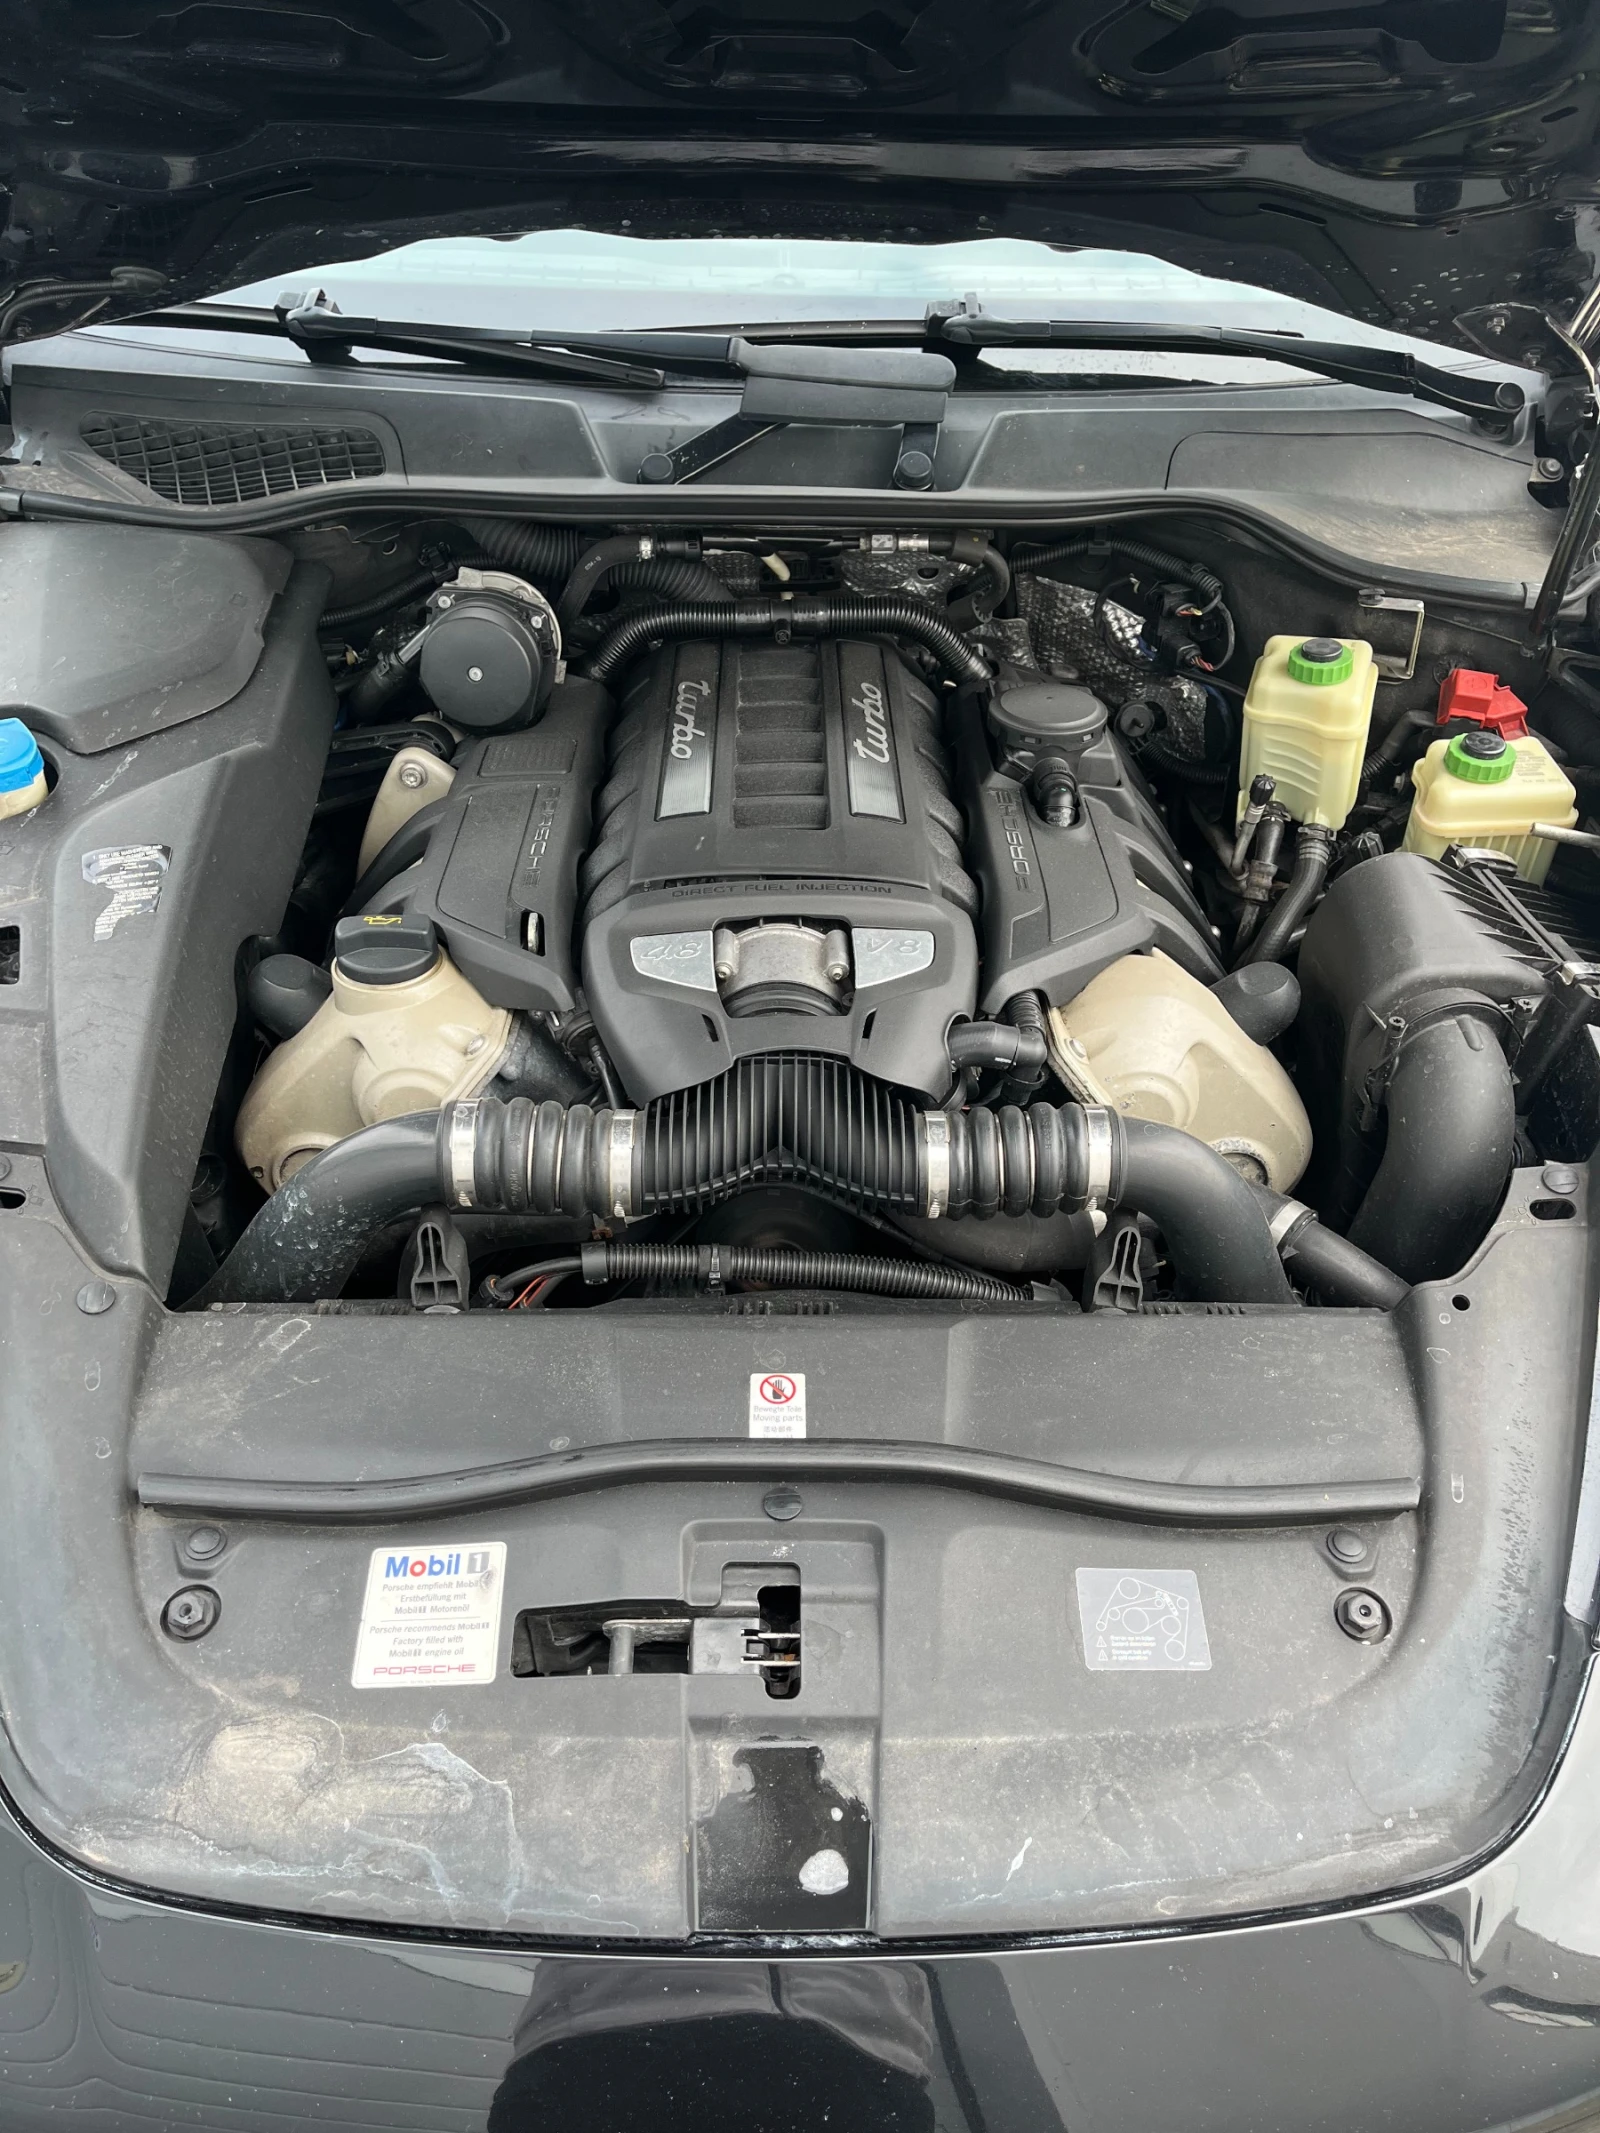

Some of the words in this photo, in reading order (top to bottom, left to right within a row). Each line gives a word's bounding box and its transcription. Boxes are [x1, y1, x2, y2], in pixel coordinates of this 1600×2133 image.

[671, 680, 711, 759] turbo
[851, 682, 890, 763] turbo
[522, 786, 561, 888] PORSCHE
[995, 790, 1031, 891] PORSCHE
[671, 885, 738, 897] DIRECT
[744, 883, 787, 892] FUEL
[796, 883, 892, 894] INJECTION
[752, 1413, 781, 1423] Moving
[782, 1415, 804, 1423] parts
[385, 1553, 461, 1578] Mobil
[382, 1583, 415, 1592] Porsche
[416, 1581, 454, 1592] empfiehlt
[400, 1592, 452, 1604] Erstbefüllung
[453, 1593, 467, 1601] mit
[429, 1604, 470, 1614] Motorenöl
[369, 1625, 402, 1635] Porsche
[403, 1623, 456, 1634] recommends
[392, 1636, 424, 1647] Factory
[424, 1636, 446, 1645] filled
[447, 1635, 464, 1644] with
[424, 1649, 452, 1658] engine
[453, 1646, 465, 1656] oil
[373, 1663, 477, 1676] PORSCHE
